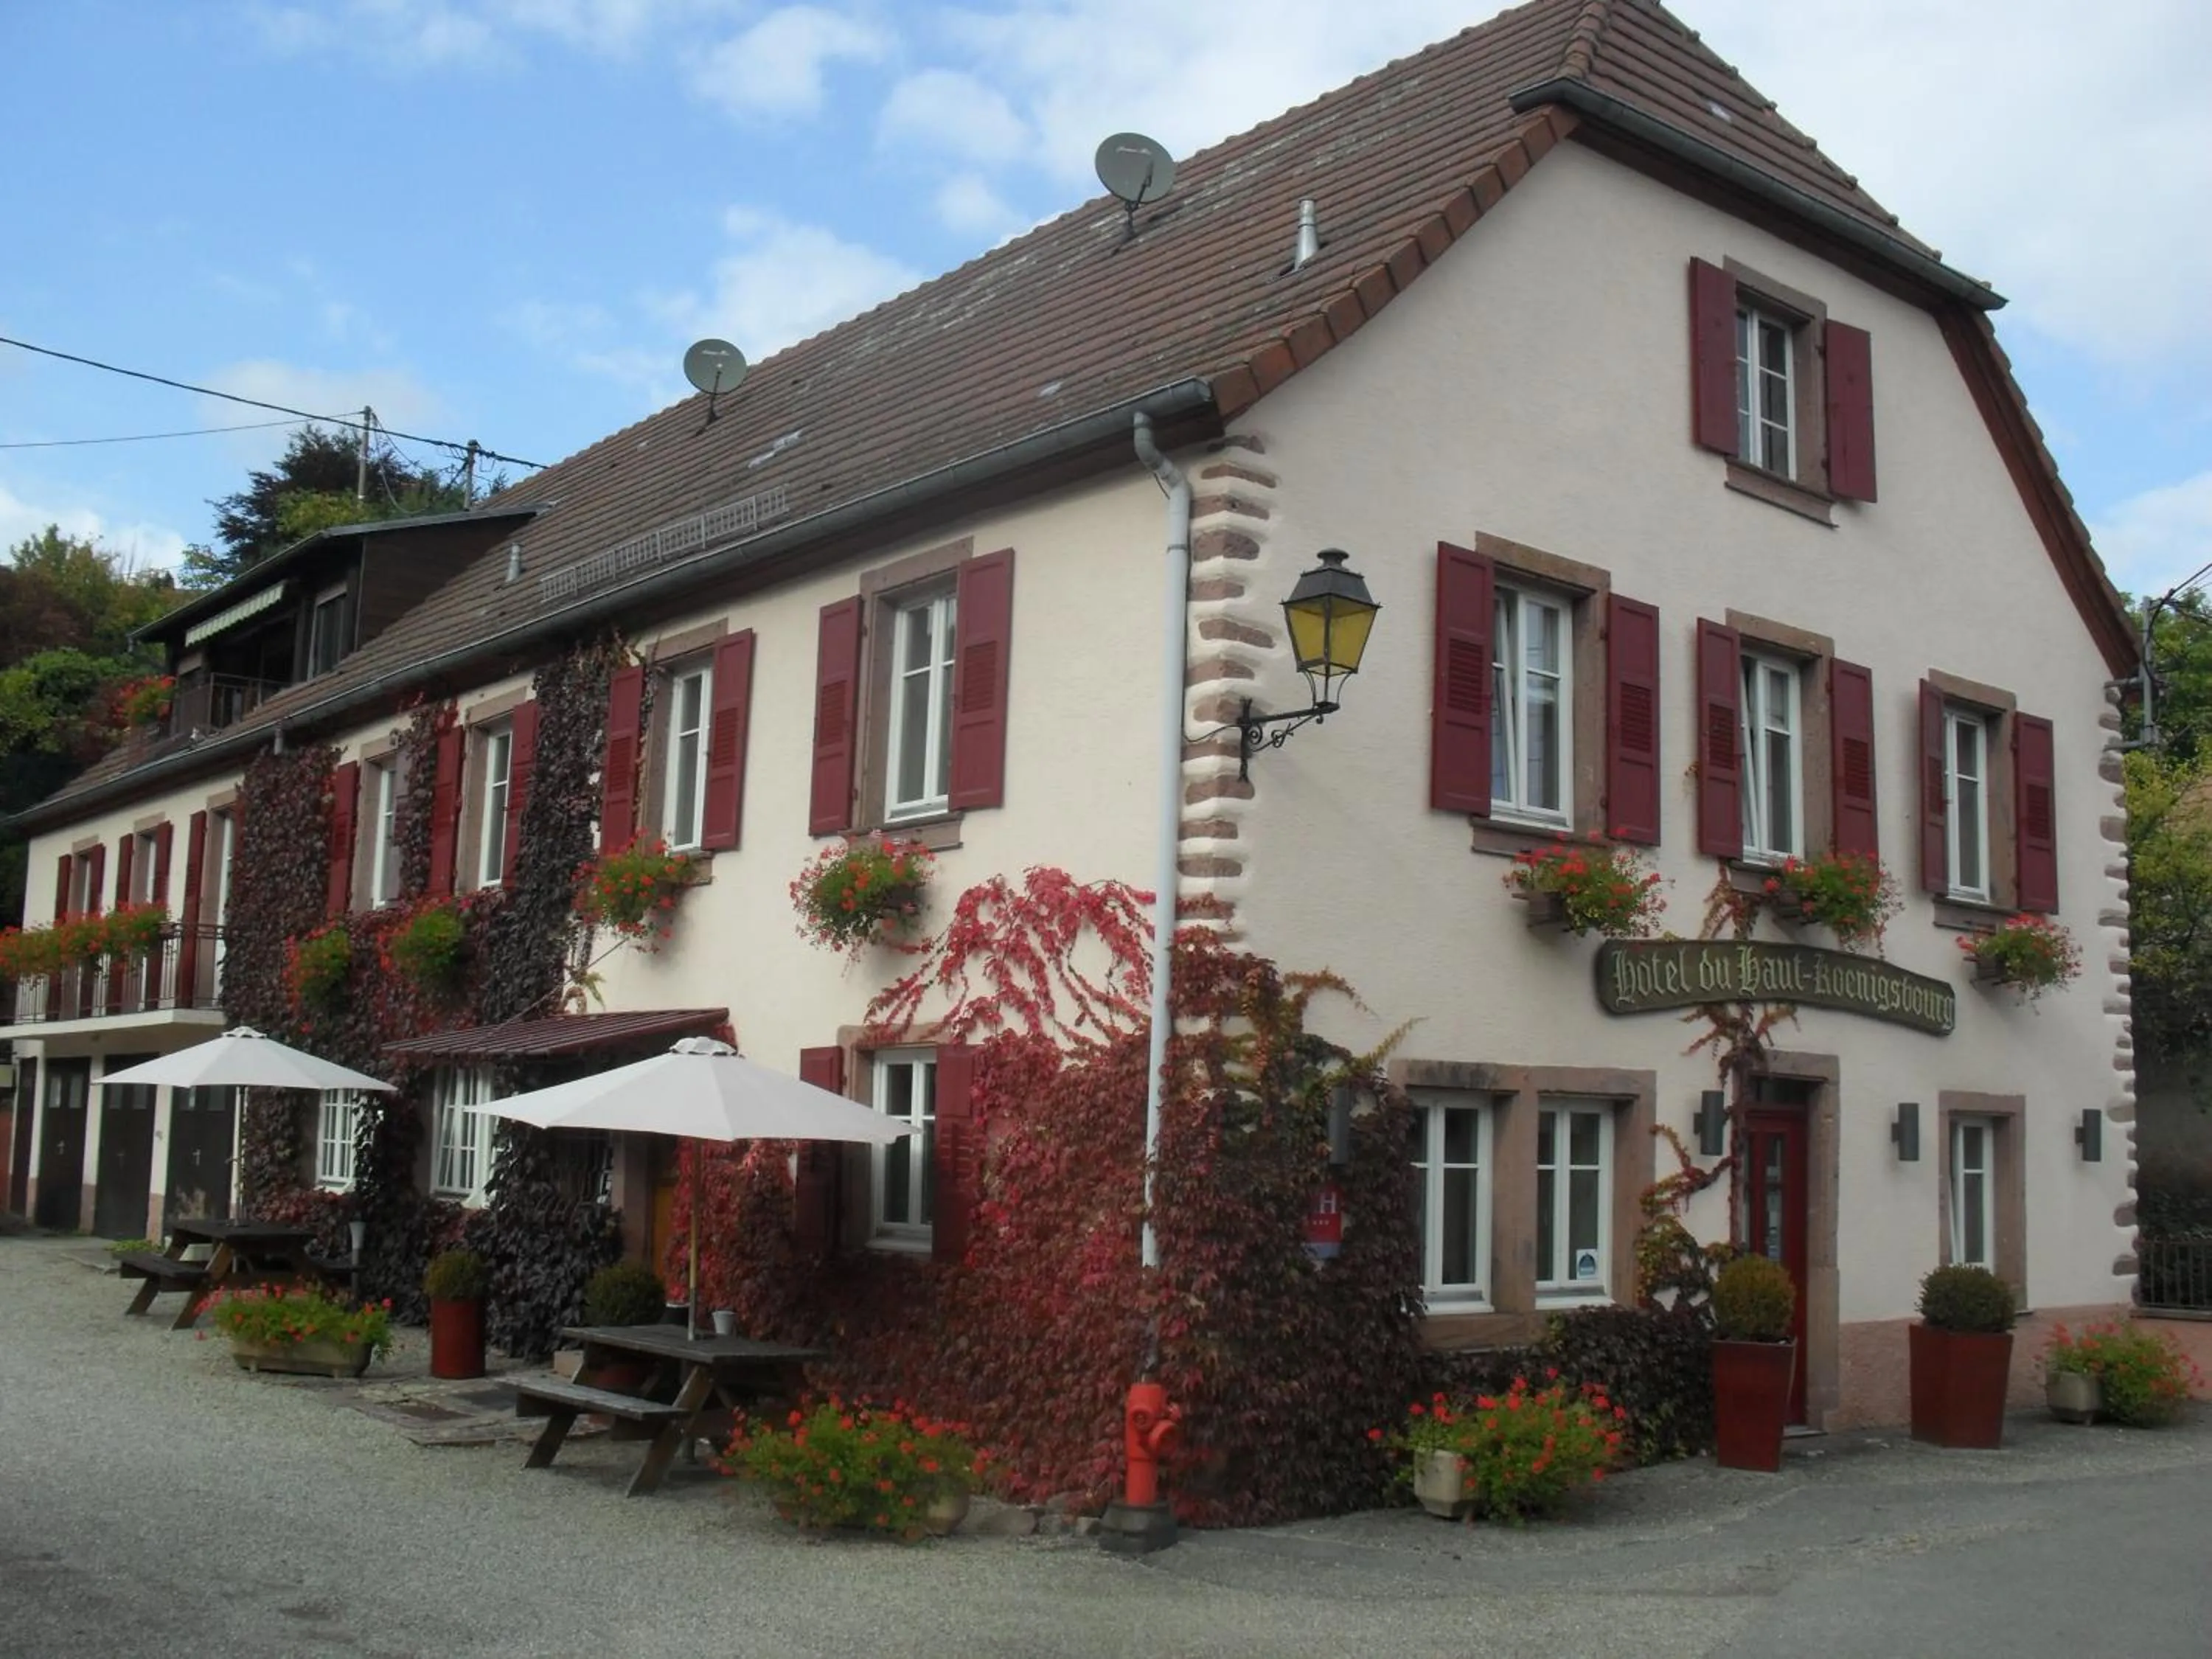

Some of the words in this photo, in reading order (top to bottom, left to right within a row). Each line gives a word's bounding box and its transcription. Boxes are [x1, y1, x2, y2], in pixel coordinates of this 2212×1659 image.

[1699, 947, 1732, 992] du
[1736, 945, 1954, 1030] Haut-Koenigsbourg
[1320, 1191, 1337, 1214] H
